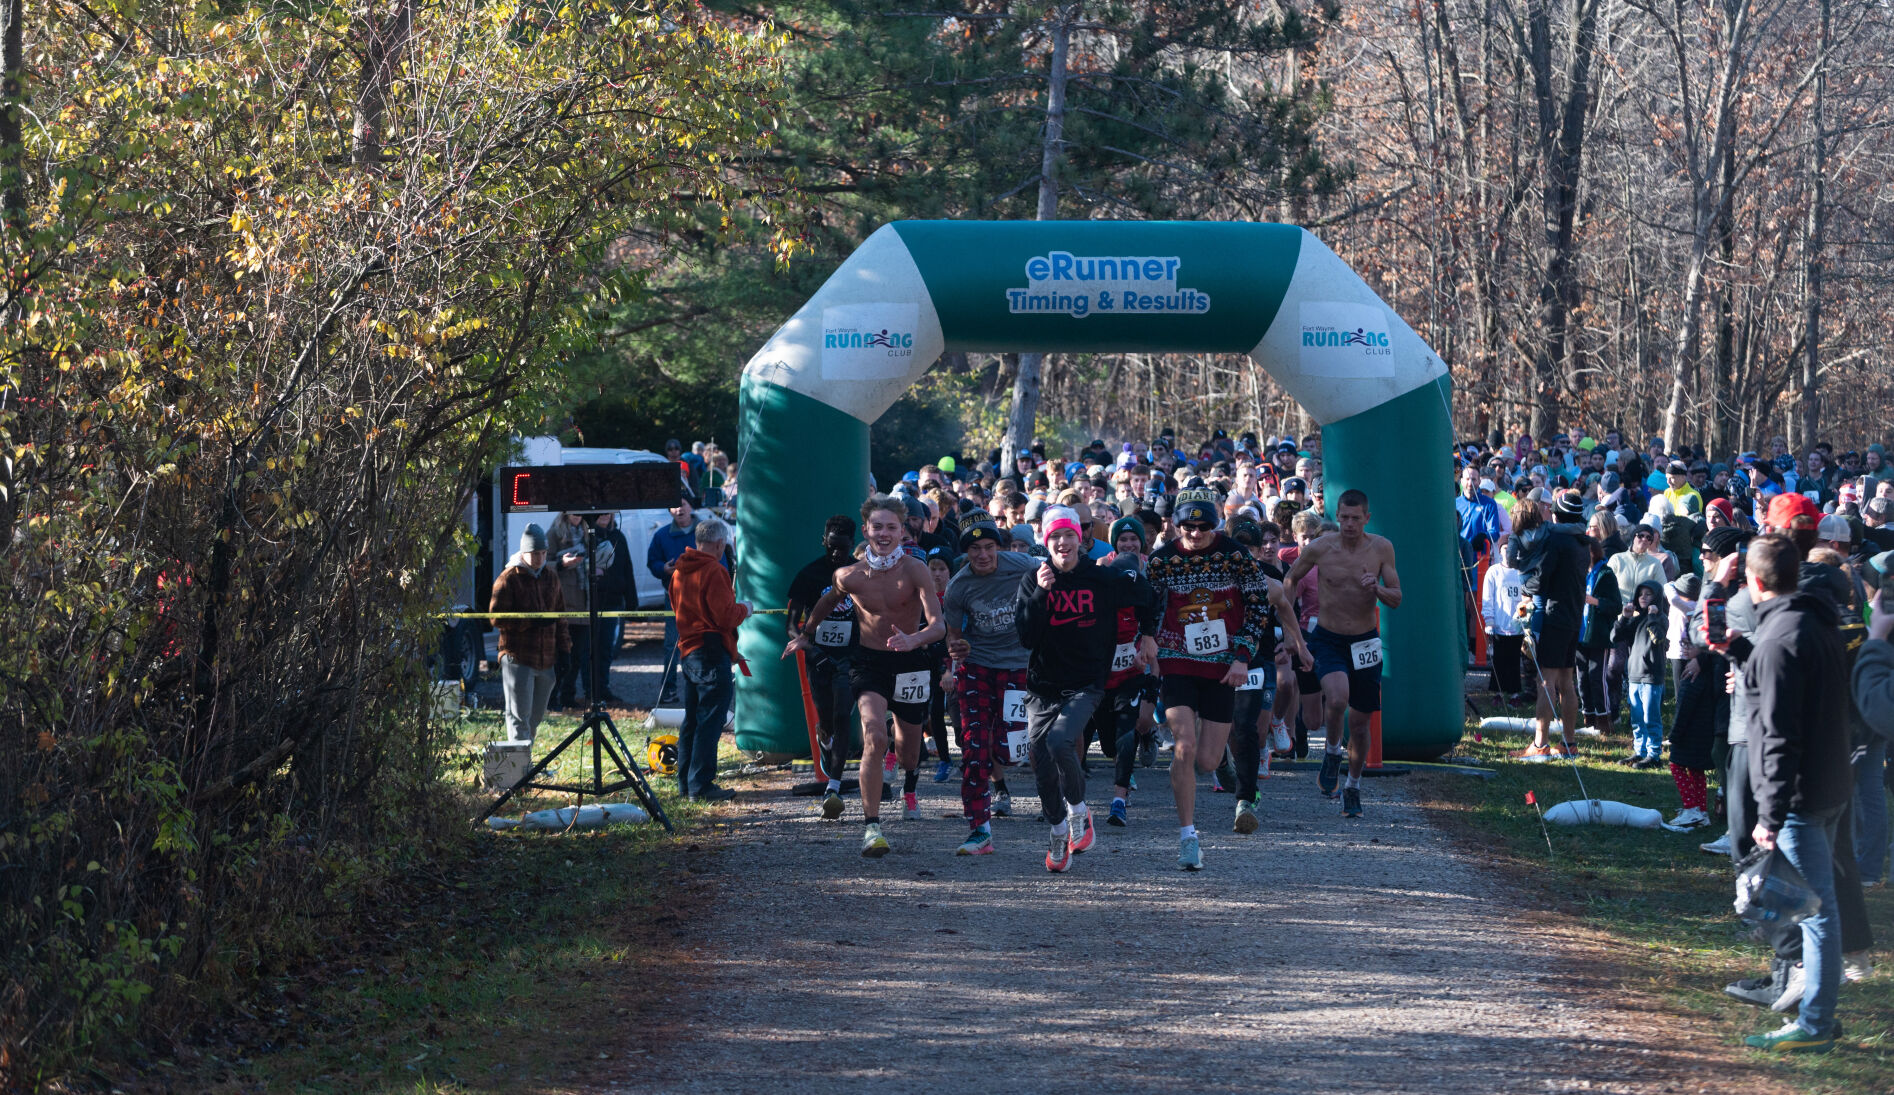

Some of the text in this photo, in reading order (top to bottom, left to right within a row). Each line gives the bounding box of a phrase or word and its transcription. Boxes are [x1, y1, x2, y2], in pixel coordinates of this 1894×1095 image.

[1028, 253, 1178, 281] eRunner
[1009, 291, 1208, 315] Timing & Results
[887, 349, 912, 357] CLUB
[1365, 348, 1391, 356] CLUB
[1046, 589, 1094, 613] NXR
[821, 631, 845, 644] 525
[1194, 634, 1220, 651] 583
[1358, 650, 1378, 666] 926
[901, 685, 924, 700] 570
[1010, 703, 1029, 718] 79
